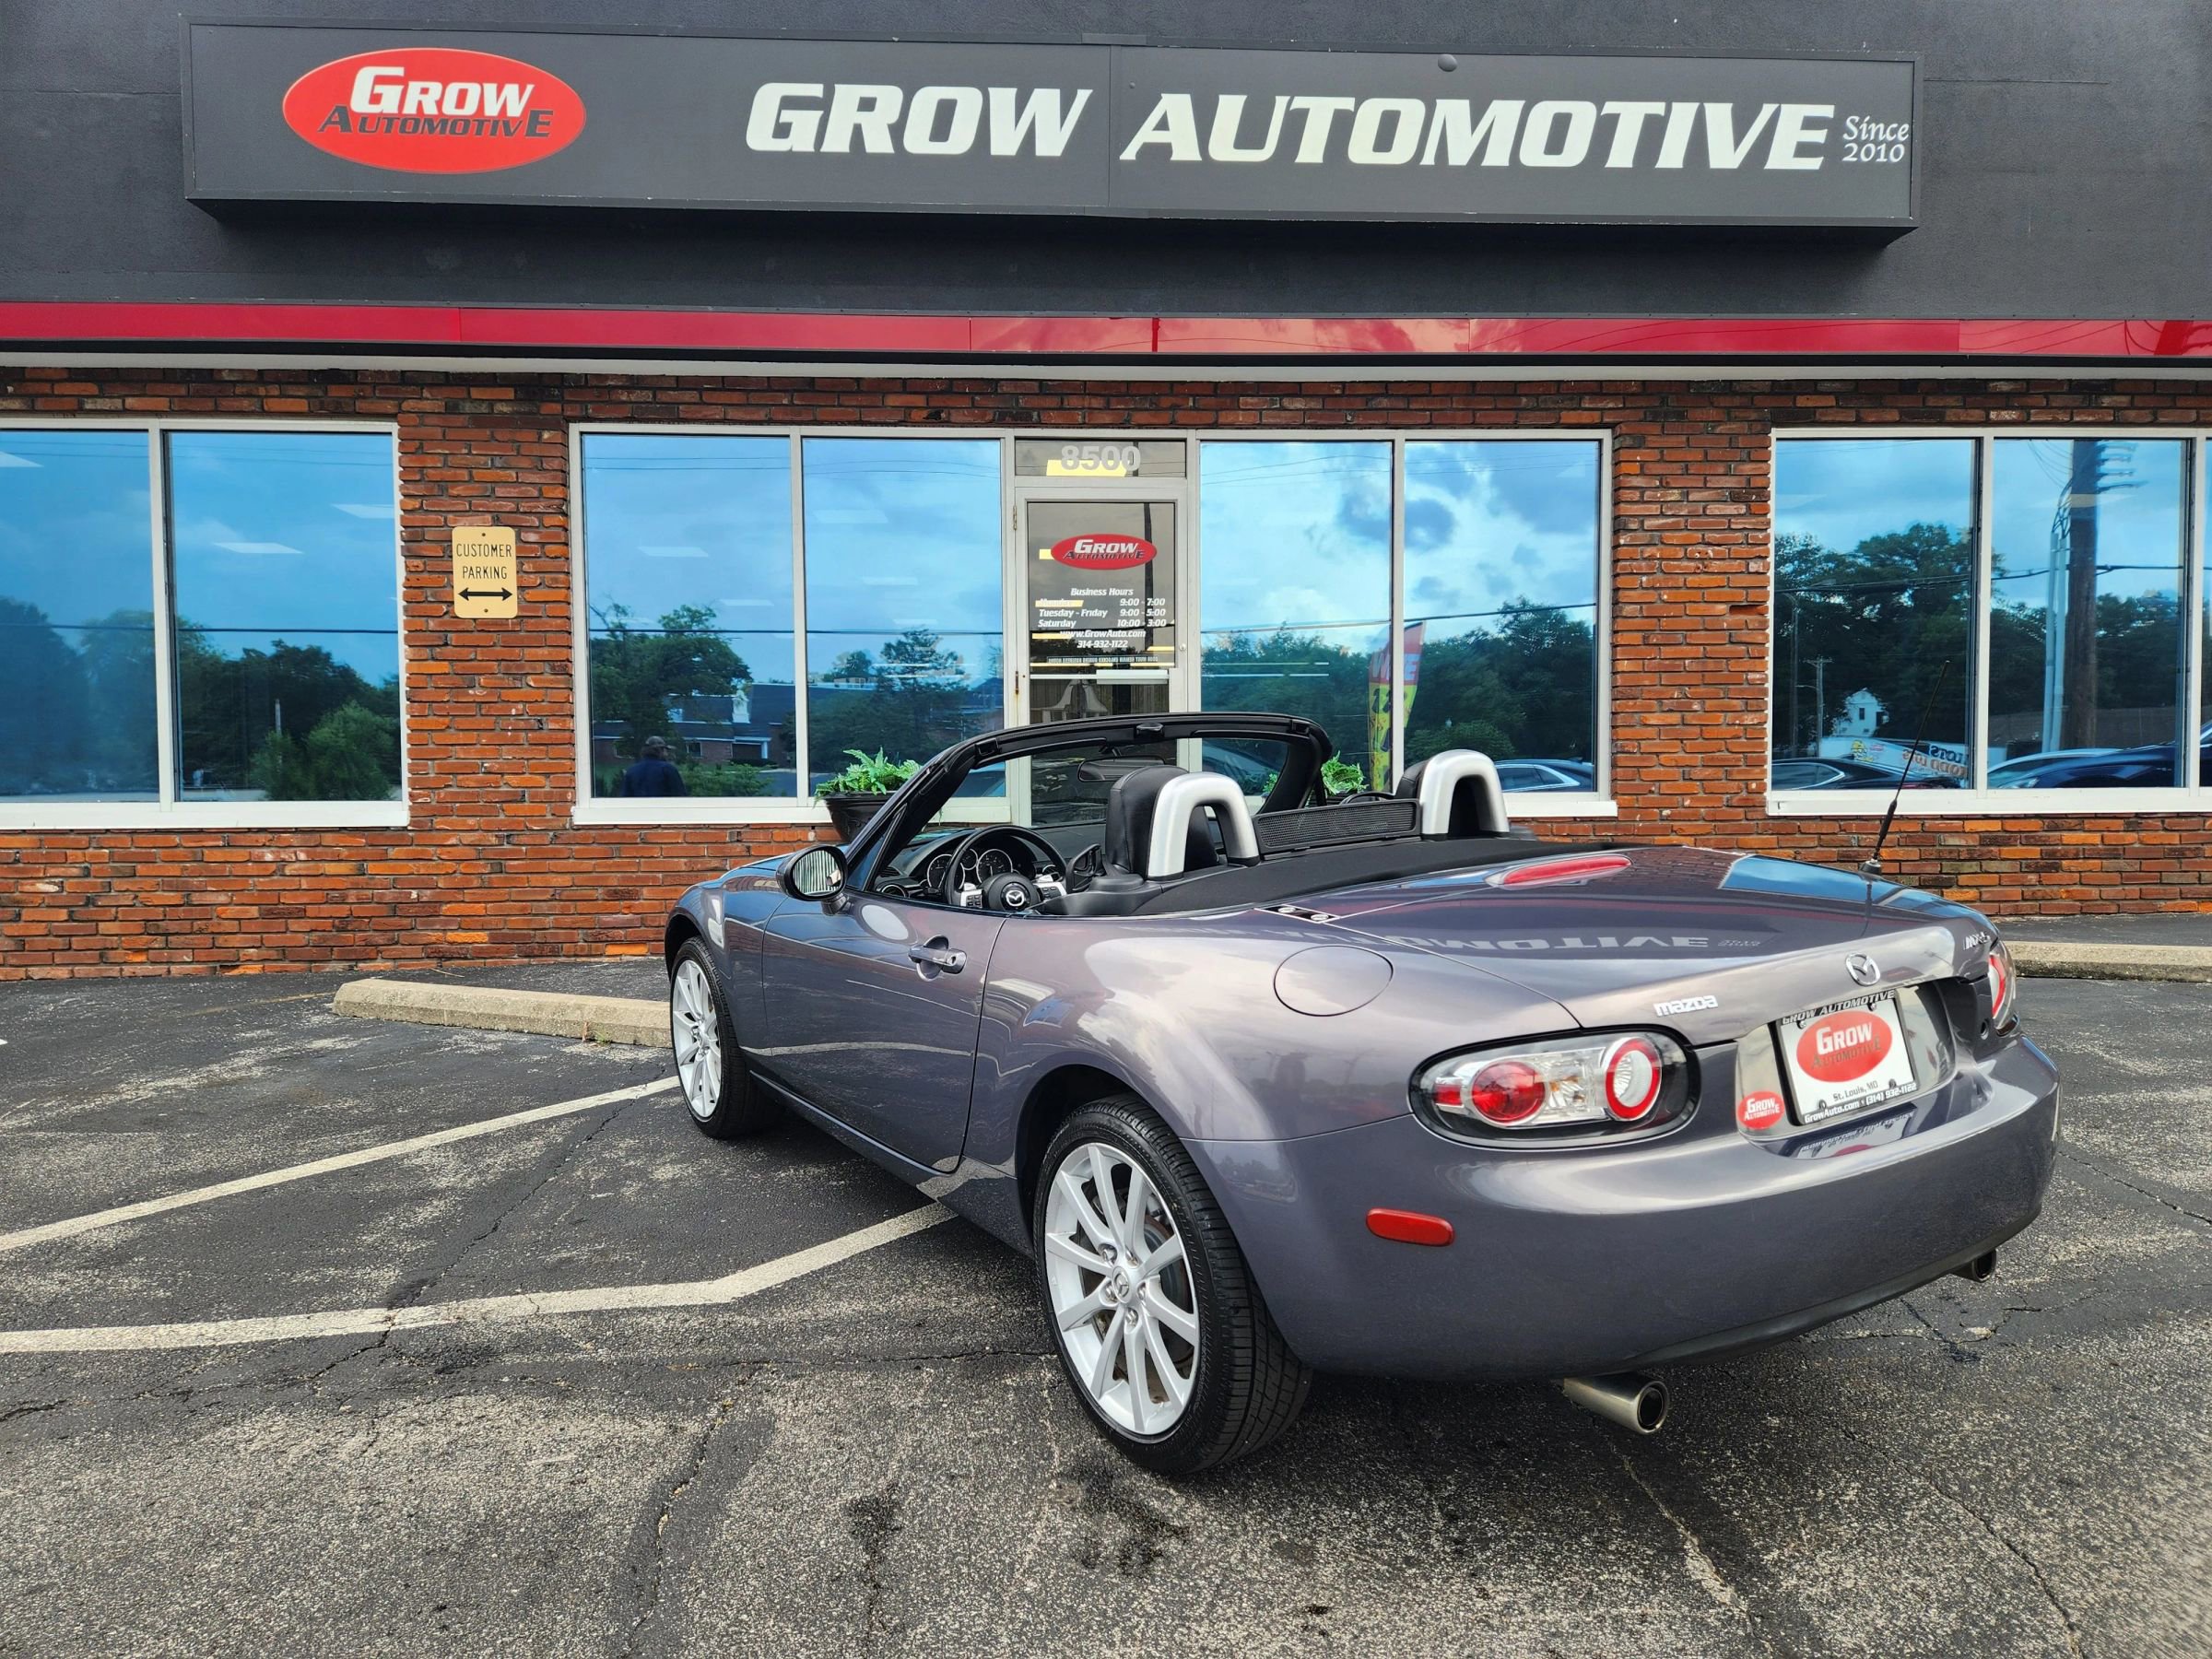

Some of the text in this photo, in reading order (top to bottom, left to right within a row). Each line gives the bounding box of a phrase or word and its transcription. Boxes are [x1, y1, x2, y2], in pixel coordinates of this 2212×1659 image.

[349, 65, 535, 118] GROW
[317, 104, 554, 138] AUTOMOTIVE
[745, 81, 1835, 171] GROW AUTOMOTIVE
[1842, 115, 1910, 142] Since
[1841, 142, 1906, 163] 2010
[1061, 445, 1141, 472] 8500
[455, 543, 512, 558] CUSTOMER
[1062, 549, 1146, 560] AUTOMOTIVE
[1074, 538, 1140, 554] GROW
[462, 565, 508, 580] PARKING
[1070, 587, 1135, 596] Business Hours
[1119, 597, 1140, 606] 9:00
[1147, 597, 1166, 606] 7:00
[1037, 618, 1077, 629] Saturday
[1117, 618, 1141, 628] 10:00
[1147, 618, 1167, 627] 3:00
[1039, 608, 1075, 618] Tuesday
[1080, 608, 1109, 618] Friday
[1119, 608, 1140, 617] 9:00
[1146, 608, 1166, 617] 5:00
[1077, 640, 1129, 649] 314-932-1122
[1782, 990, 1896, 1025] GROW AUTOMOTIVE
[1816, 1022, 1873, 1055] GROW
[1832, 1079, 1878, 1101] St. Louis, MO
[1804, 1082, 1918, 1124] GrowAuto.com (314) 932-1122
